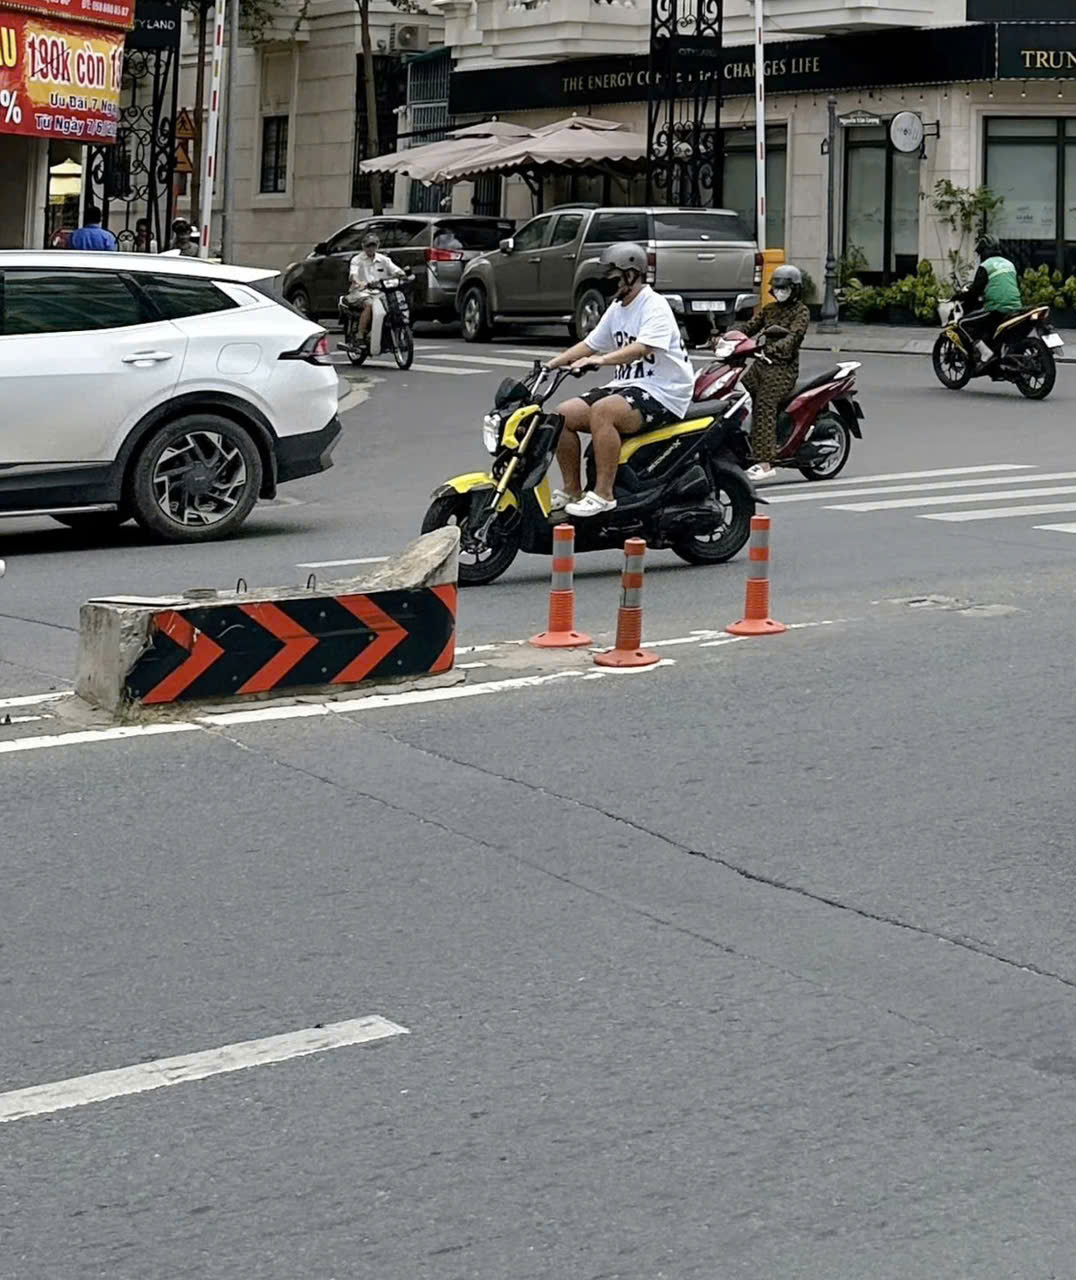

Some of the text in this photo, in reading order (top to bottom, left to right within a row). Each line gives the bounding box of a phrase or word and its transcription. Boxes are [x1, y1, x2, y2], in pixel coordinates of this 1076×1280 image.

[562, 77, 584, 92] THE
[588, 71, 634, 90] ENERGY
[791, 56, 820, 73] LIFE
